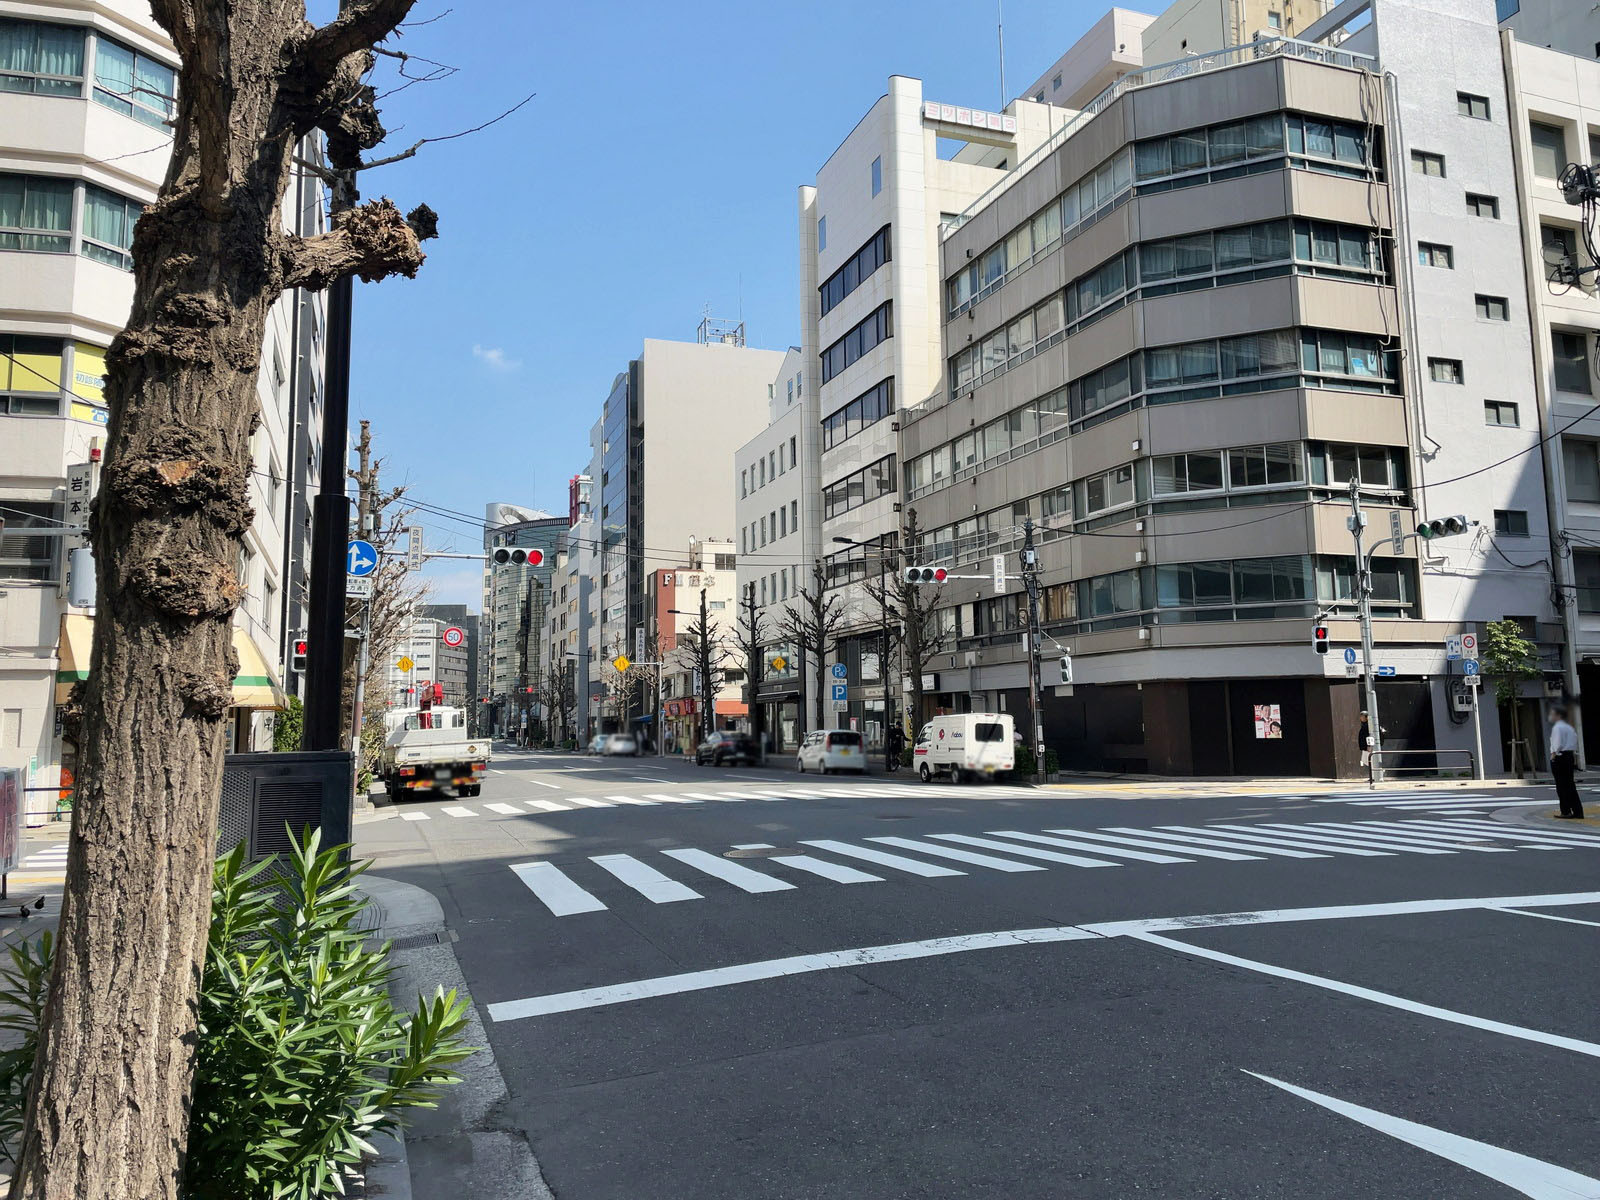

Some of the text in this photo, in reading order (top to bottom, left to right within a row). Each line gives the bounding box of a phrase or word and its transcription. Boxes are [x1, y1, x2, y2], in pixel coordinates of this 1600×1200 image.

[411, 529, 420, 568] 夜間点滅式
[448, 632, 459, 642] 50
[835, 686, 844, 699] P
